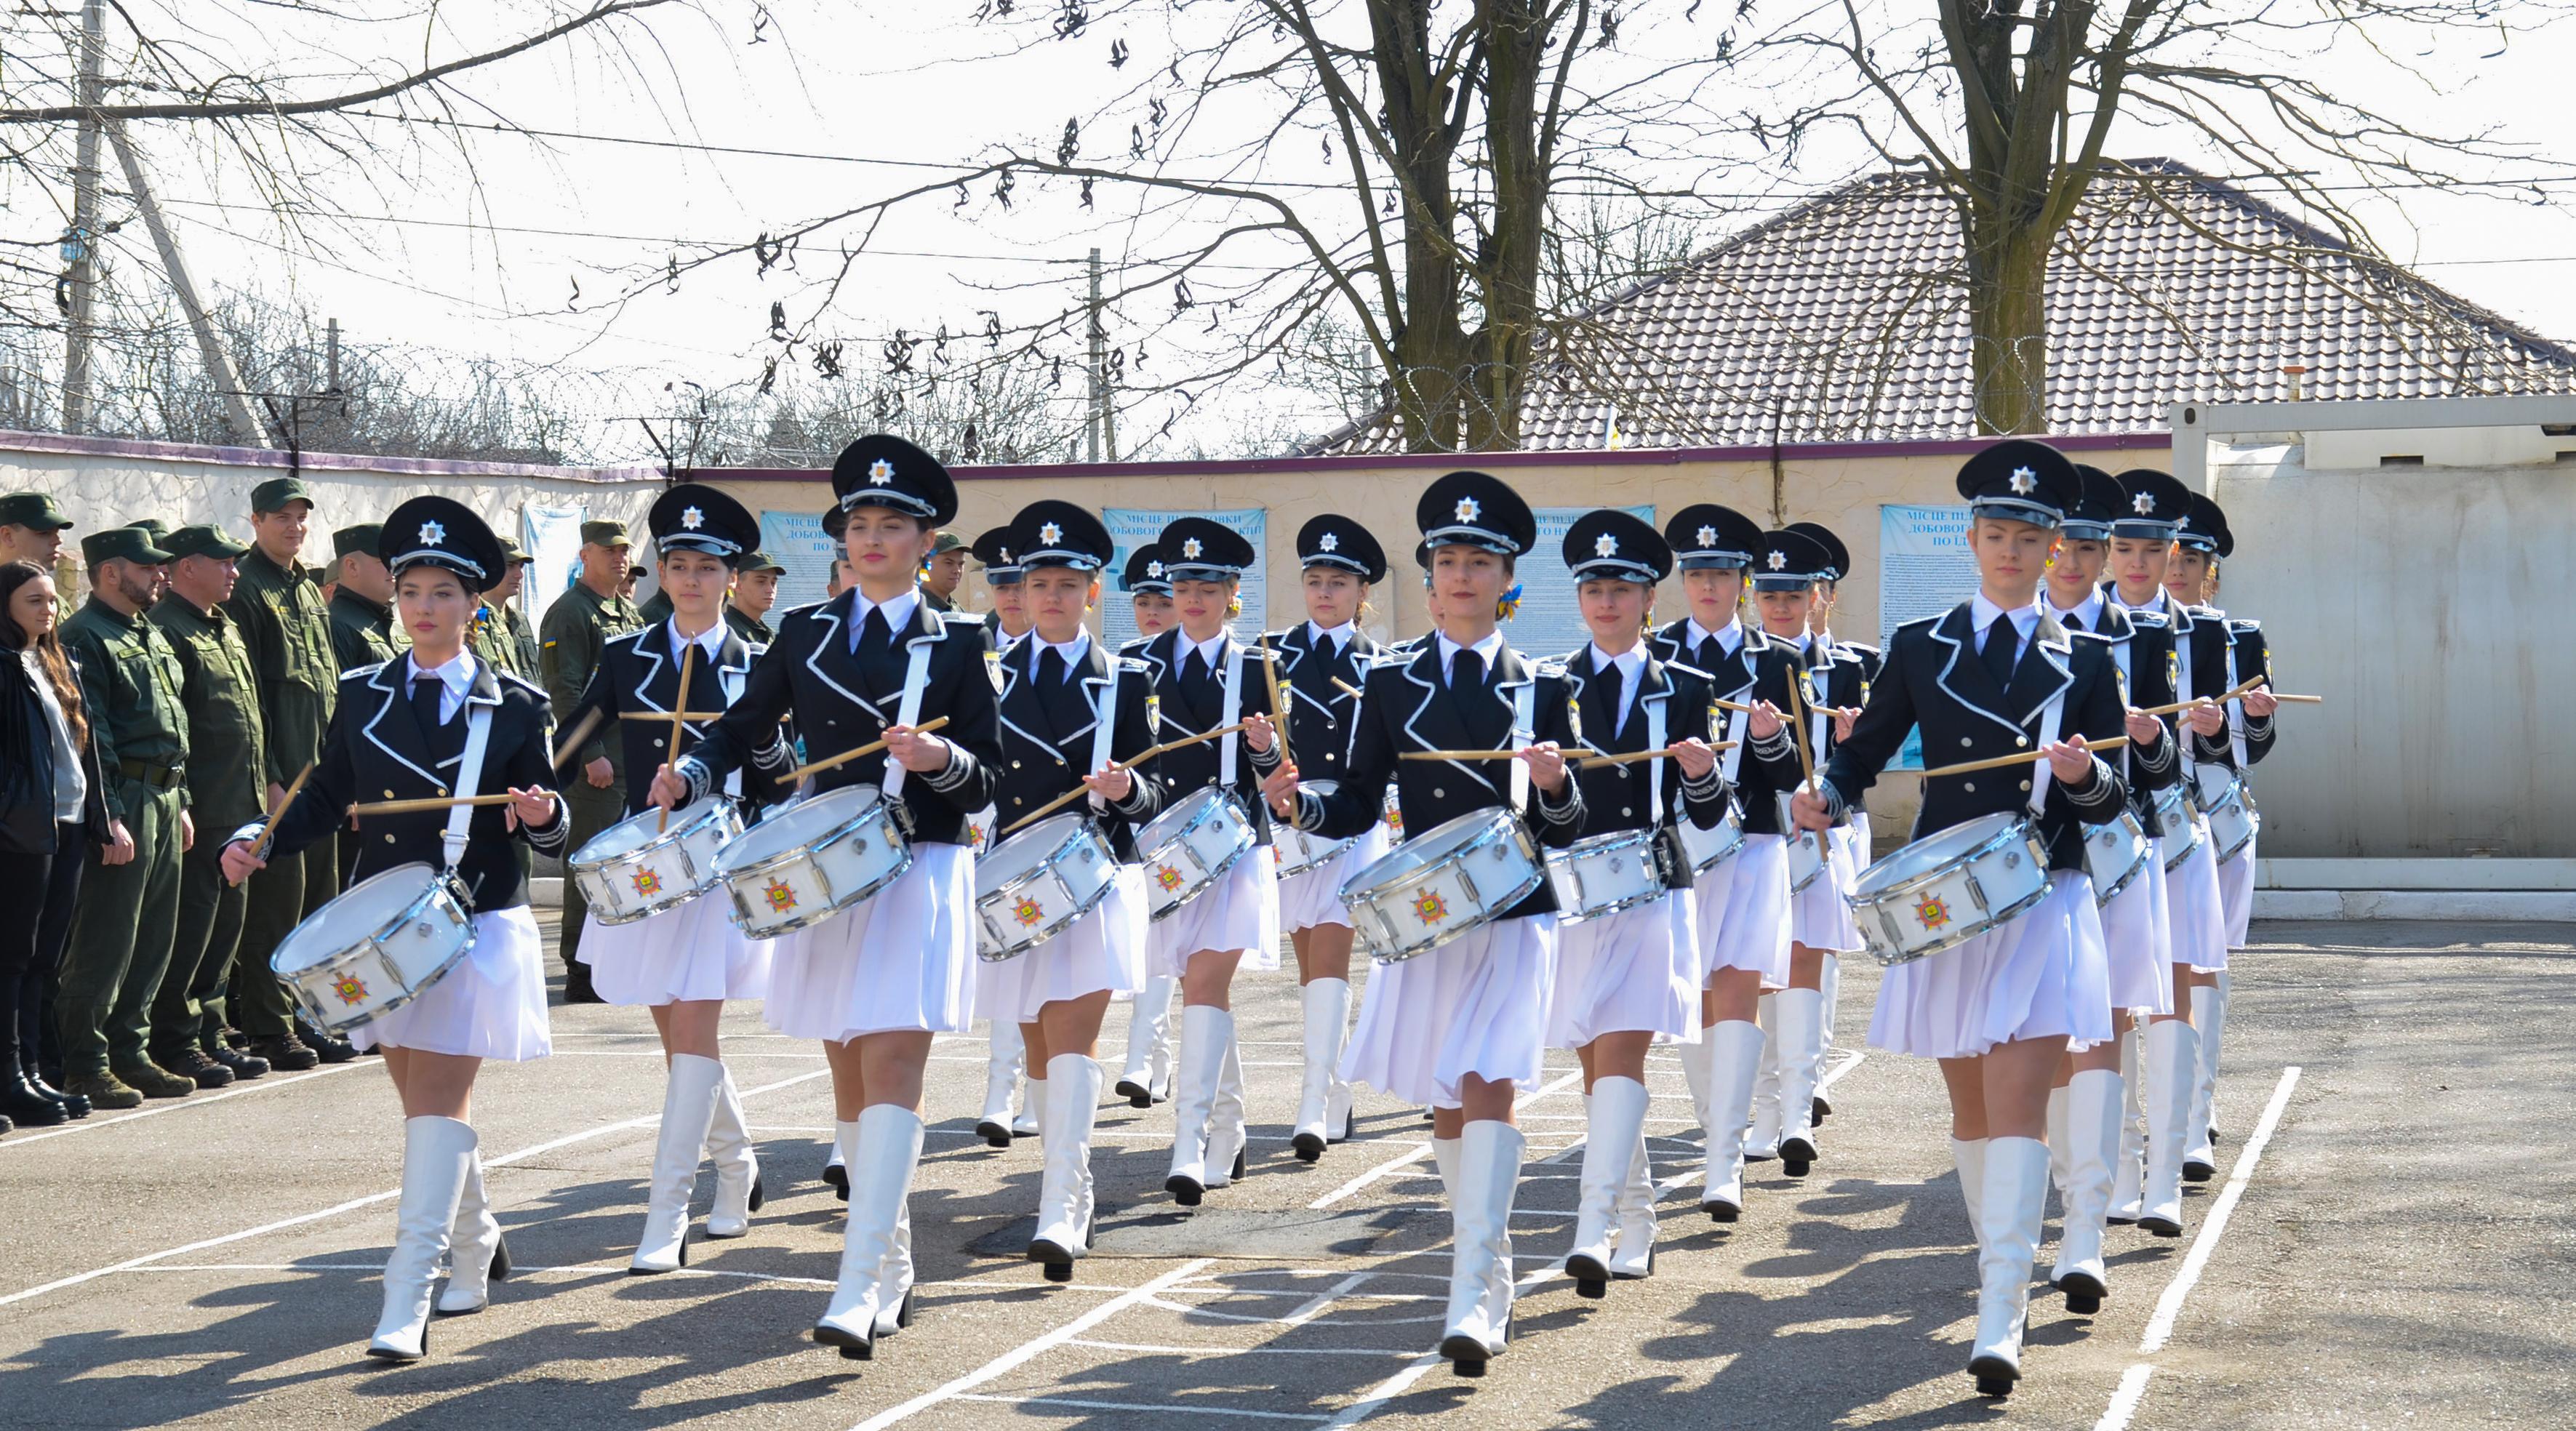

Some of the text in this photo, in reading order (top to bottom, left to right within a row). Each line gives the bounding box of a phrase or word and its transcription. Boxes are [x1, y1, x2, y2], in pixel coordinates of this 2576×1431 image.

[1127, 514, 1163, 524] МІСЦЕ
[1907, 511, 1947, 521] МІСЦЕ
[1933, 537, 1951, 546] ПО
[813, 542, 829, 551] ПО
